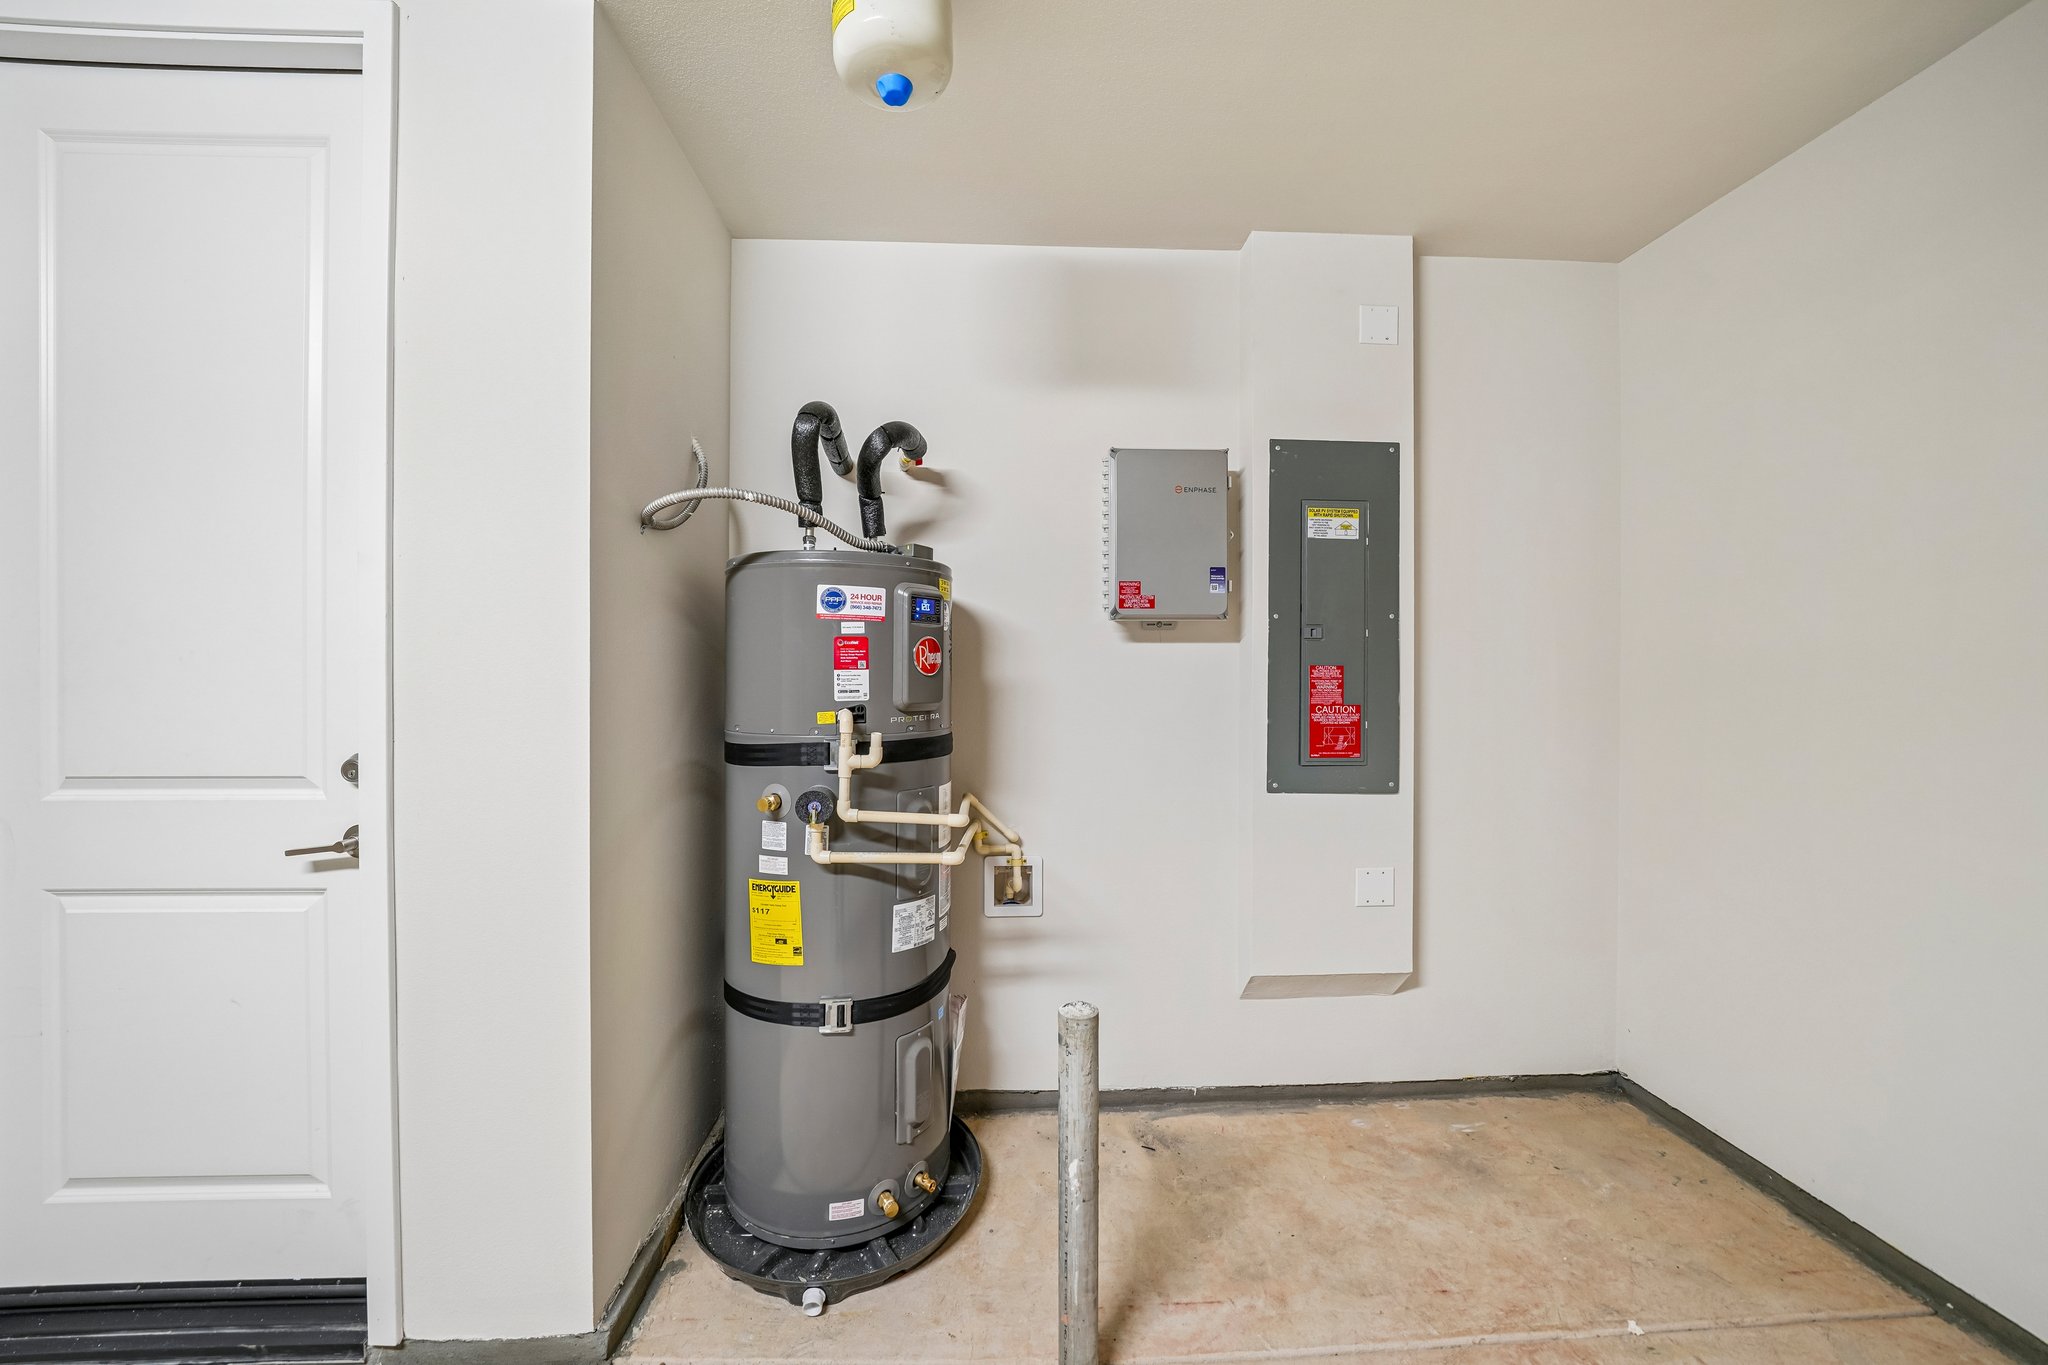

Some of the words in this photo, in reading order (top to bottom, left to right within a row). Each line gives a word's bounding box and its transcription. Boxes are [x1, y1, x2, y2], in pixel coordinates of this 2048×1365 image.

[1316, 706, 1356, 714] CAUTION
[752, 883, 796, 893] ENERGYGUIDE
[752, 907, 770, 915] $117
